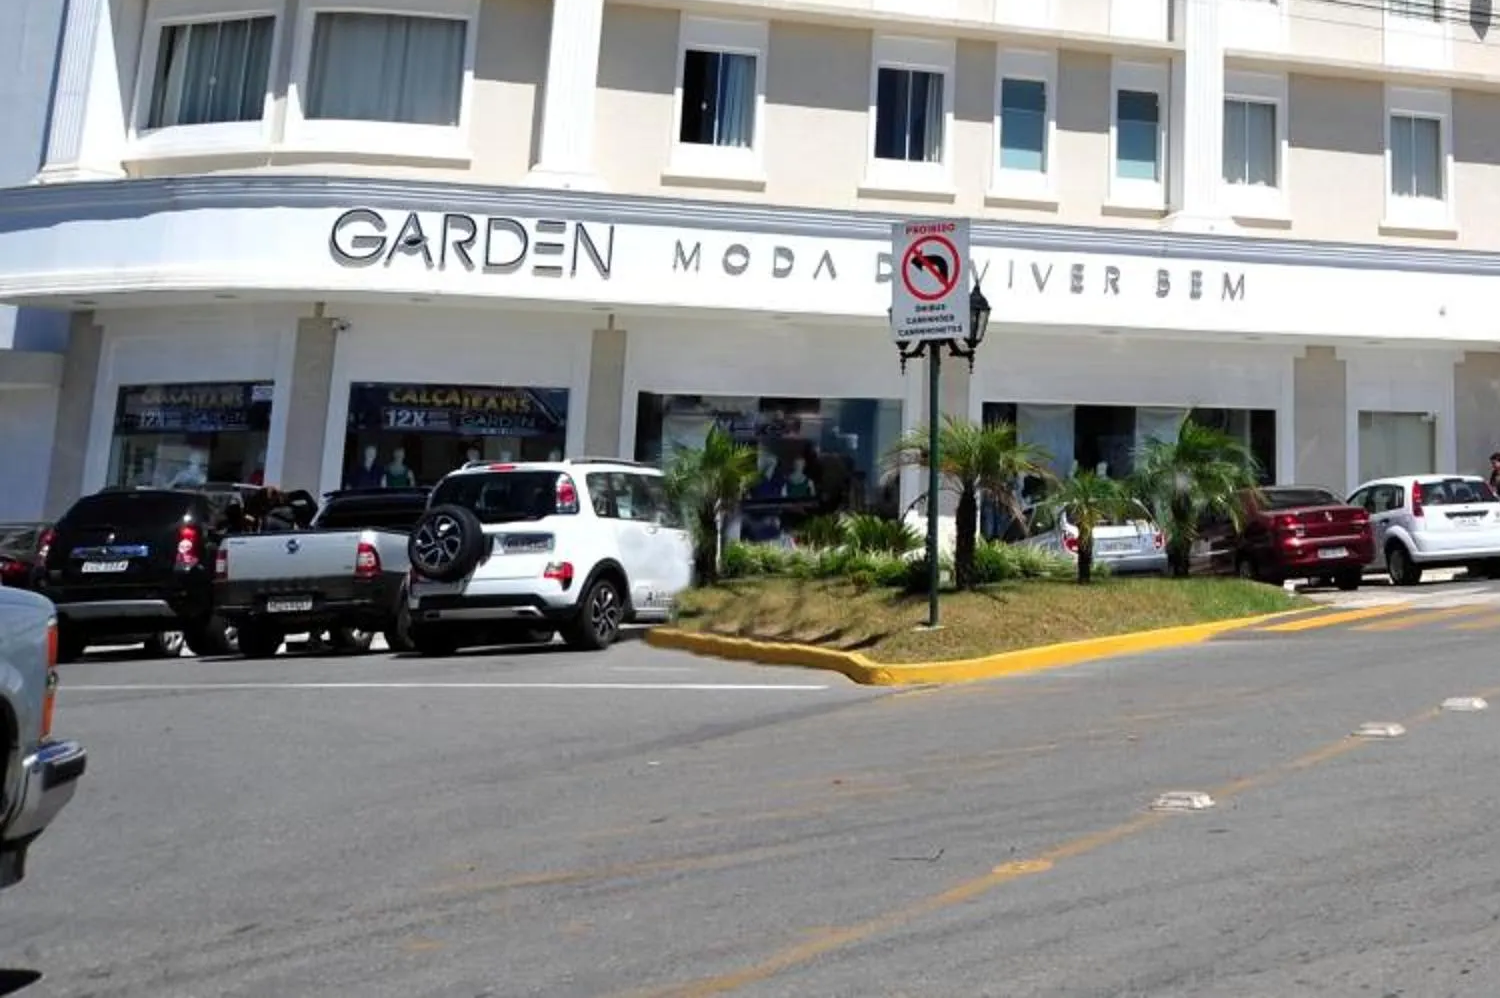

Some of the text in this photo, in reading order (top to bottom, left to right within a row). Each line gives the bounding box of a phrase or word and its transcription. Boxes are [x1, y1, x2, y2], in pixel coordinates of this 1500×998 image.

[330, 208, 614, 280] GARDEN
[672, 239, 836, 280] MODA
[970, 259, 1120, 295] VIVER
[1156, 268, 1245, 301] BEM
